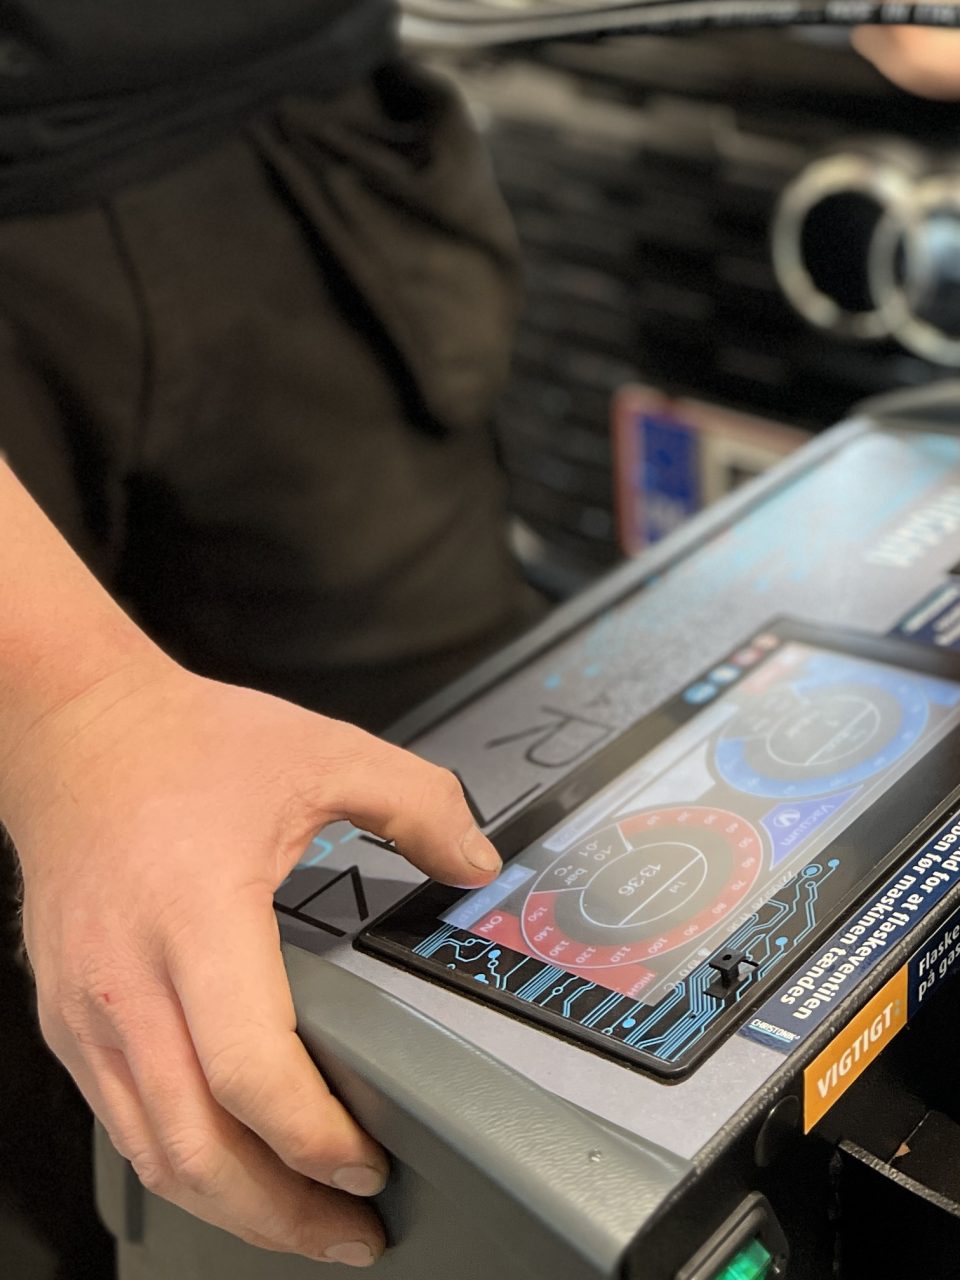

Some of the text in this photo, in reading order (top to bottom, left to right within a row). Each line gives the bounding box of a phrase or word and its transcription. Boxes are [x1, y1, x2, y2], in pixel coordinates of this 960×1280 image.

[781, 803, 834, 846] Vacuum
[564, 867, 588, 885] bar
[913, 853, 942, 875] før
[920, 871, 949, 893] for
[840, 874, 917, 944] maskinen
[901, 893, 924, 911] at
[480, 915, 503, 933] ON
[780, 947, 846, 1005] tændes
[792, 911, 910, 1019] flaskeventilen
[918, 972, 936, 1002] på
